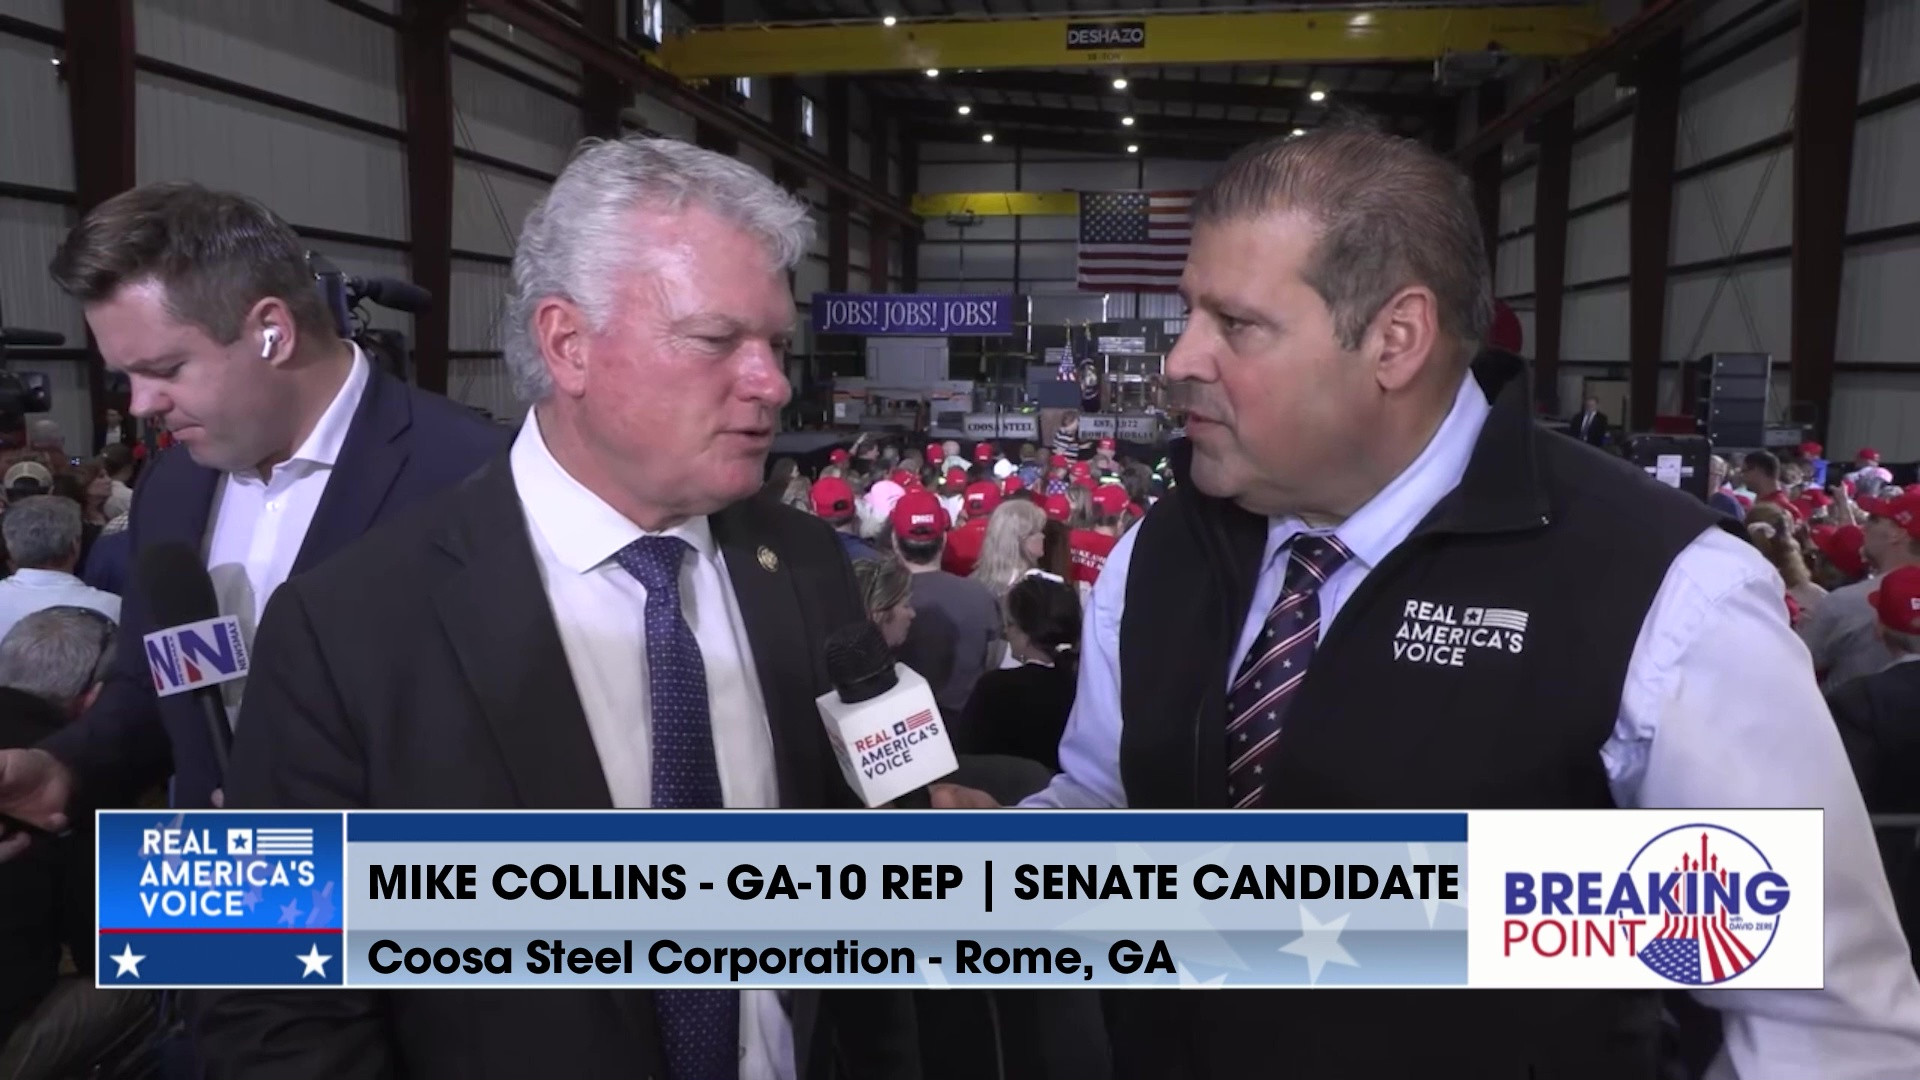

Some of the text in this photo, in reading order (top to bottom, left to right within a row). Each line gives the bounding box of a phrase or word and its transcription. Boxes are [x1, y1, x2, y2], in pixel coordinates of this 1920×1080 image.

[1068, 27, 1144, 44] DESHAZO
[823, 300, 998, 332] JOBS! JOBS! JOBS!
[1003, 423, 1033, 431] STEEL
[1403, 599, 1457, 625] REAL
[228, 622, 247, 670] NEWSMAX
[1395, 621, 1524, 654] AMERICA'S
[1392, 640, 1467, 667] VOICE
[855, 729, 892, 752] REAL
[861, 723, 939, 768] AMERICA'S
[864, 750, 913, 780] VOICE
